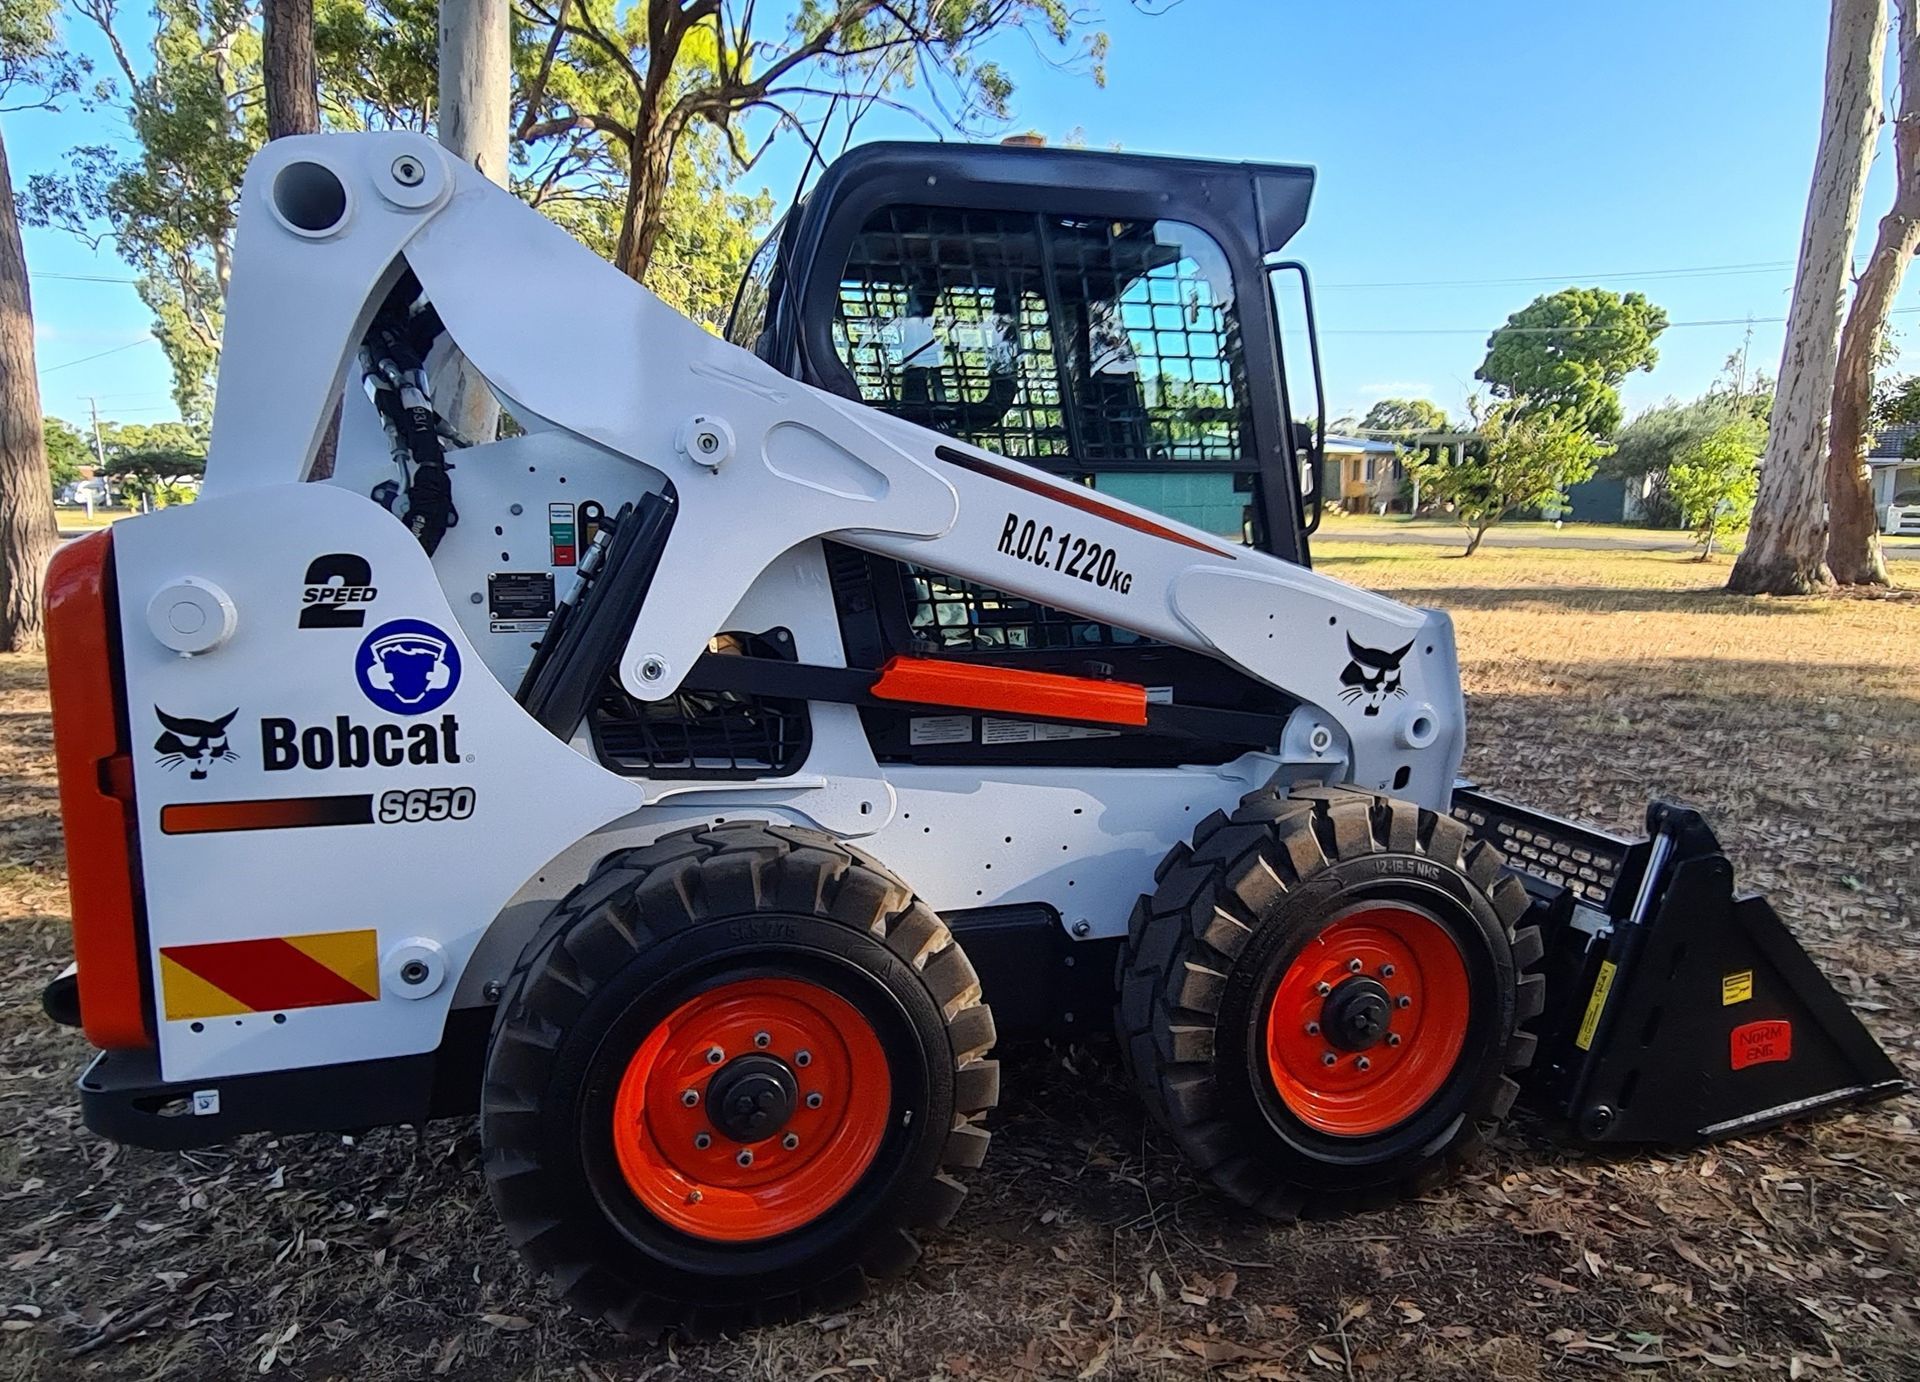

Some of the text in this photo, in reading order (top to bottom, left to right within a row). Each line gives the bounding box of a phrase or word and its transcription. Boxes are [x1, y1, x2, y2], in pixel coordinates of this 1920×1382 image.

[298, 553, 372, 629] 2
[302, 587, 378, 603] SPEED
[261, 714, 460, 771] Bobcat
[379, 787, 476, 823] S650
